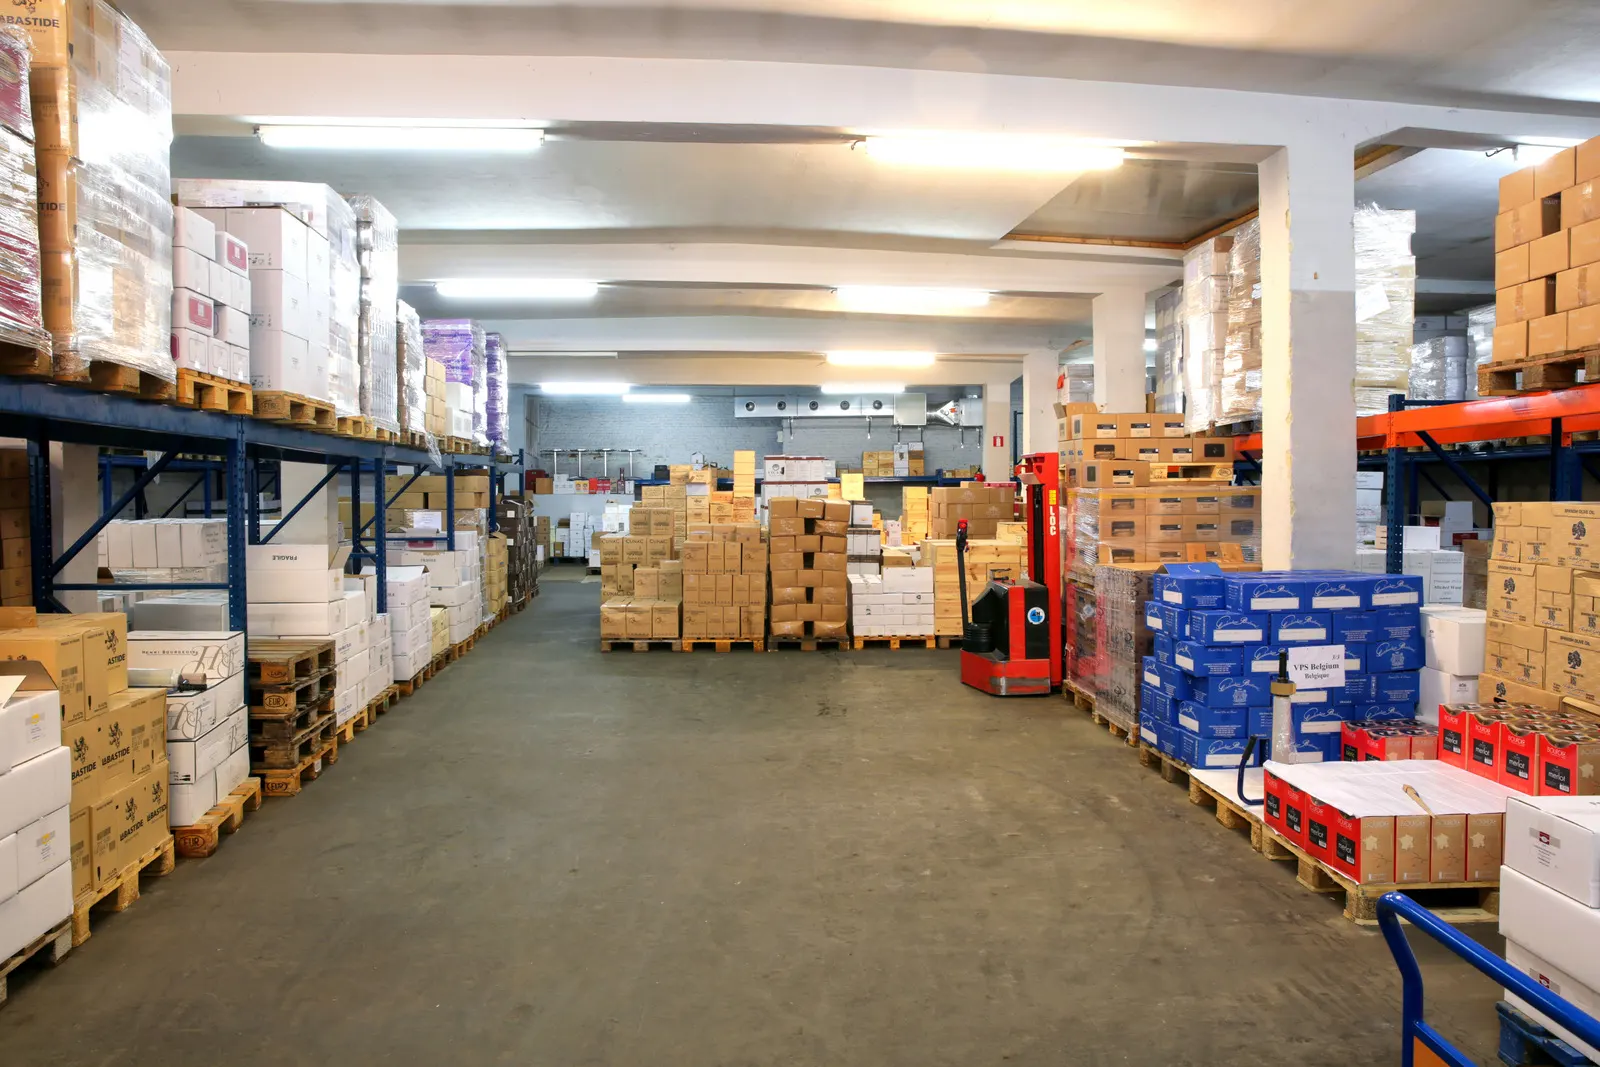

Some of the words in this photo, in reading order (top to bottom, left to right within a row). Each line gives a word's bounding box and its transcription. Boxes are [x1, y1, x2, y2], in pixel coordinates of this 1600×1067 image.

[1293, 663, 1309, 671] VPS
[1310, 662, 1340, 671] Belgium
[1444, 736, 1459, 745] merlot
[1475, 746, 1490, 756] merlot
[1508, 759, 1525, 769] merlot
[1547, 771, 1566, 782] merlot
[1310, 827, 1324, 838] merlot
[1338, 842, 1352, 854] merlot
